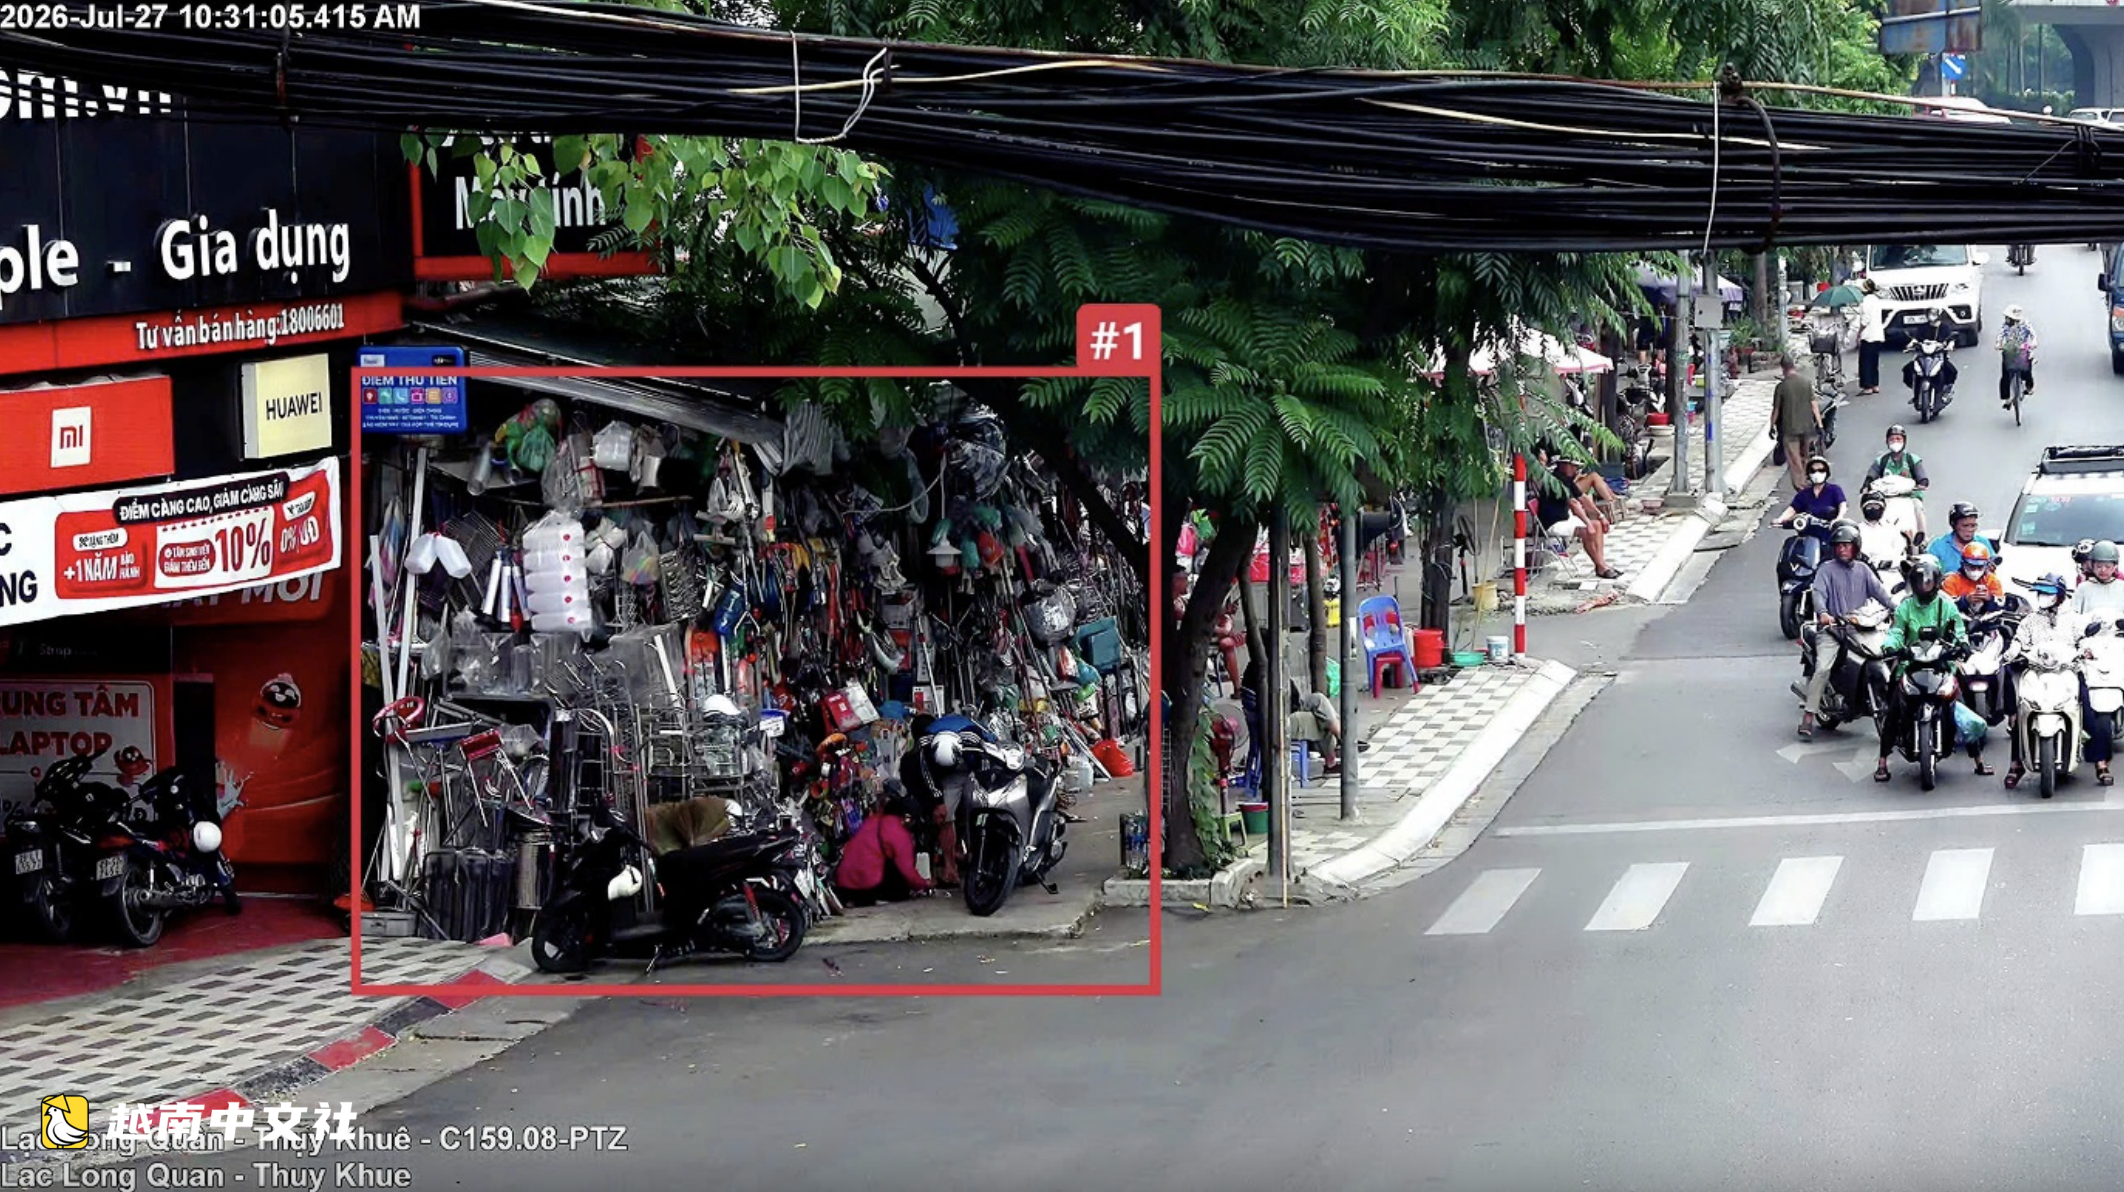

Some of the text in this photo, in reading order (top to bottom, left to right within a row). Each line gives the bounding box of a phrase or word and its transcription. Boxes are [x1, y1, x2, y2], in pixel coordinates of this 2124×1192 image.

[161, 215, 237, 279] Gia
[256, 208, 350, 284] dụng
[136, 322, 158, 349] Tư
[162, 309, 196, 347] vấn
[197, 313, 233, 343] bán
[266, 392, 322, 420] HUAWEI
[119, 498, 149, 520] ĐIỂM
[151, 498, 184, 517] CÀNG
[186, 495, 213, 514] CAO,
[215, 517, 270, 572] 10%
[0, 685, 139, 717] UNG TÂM
